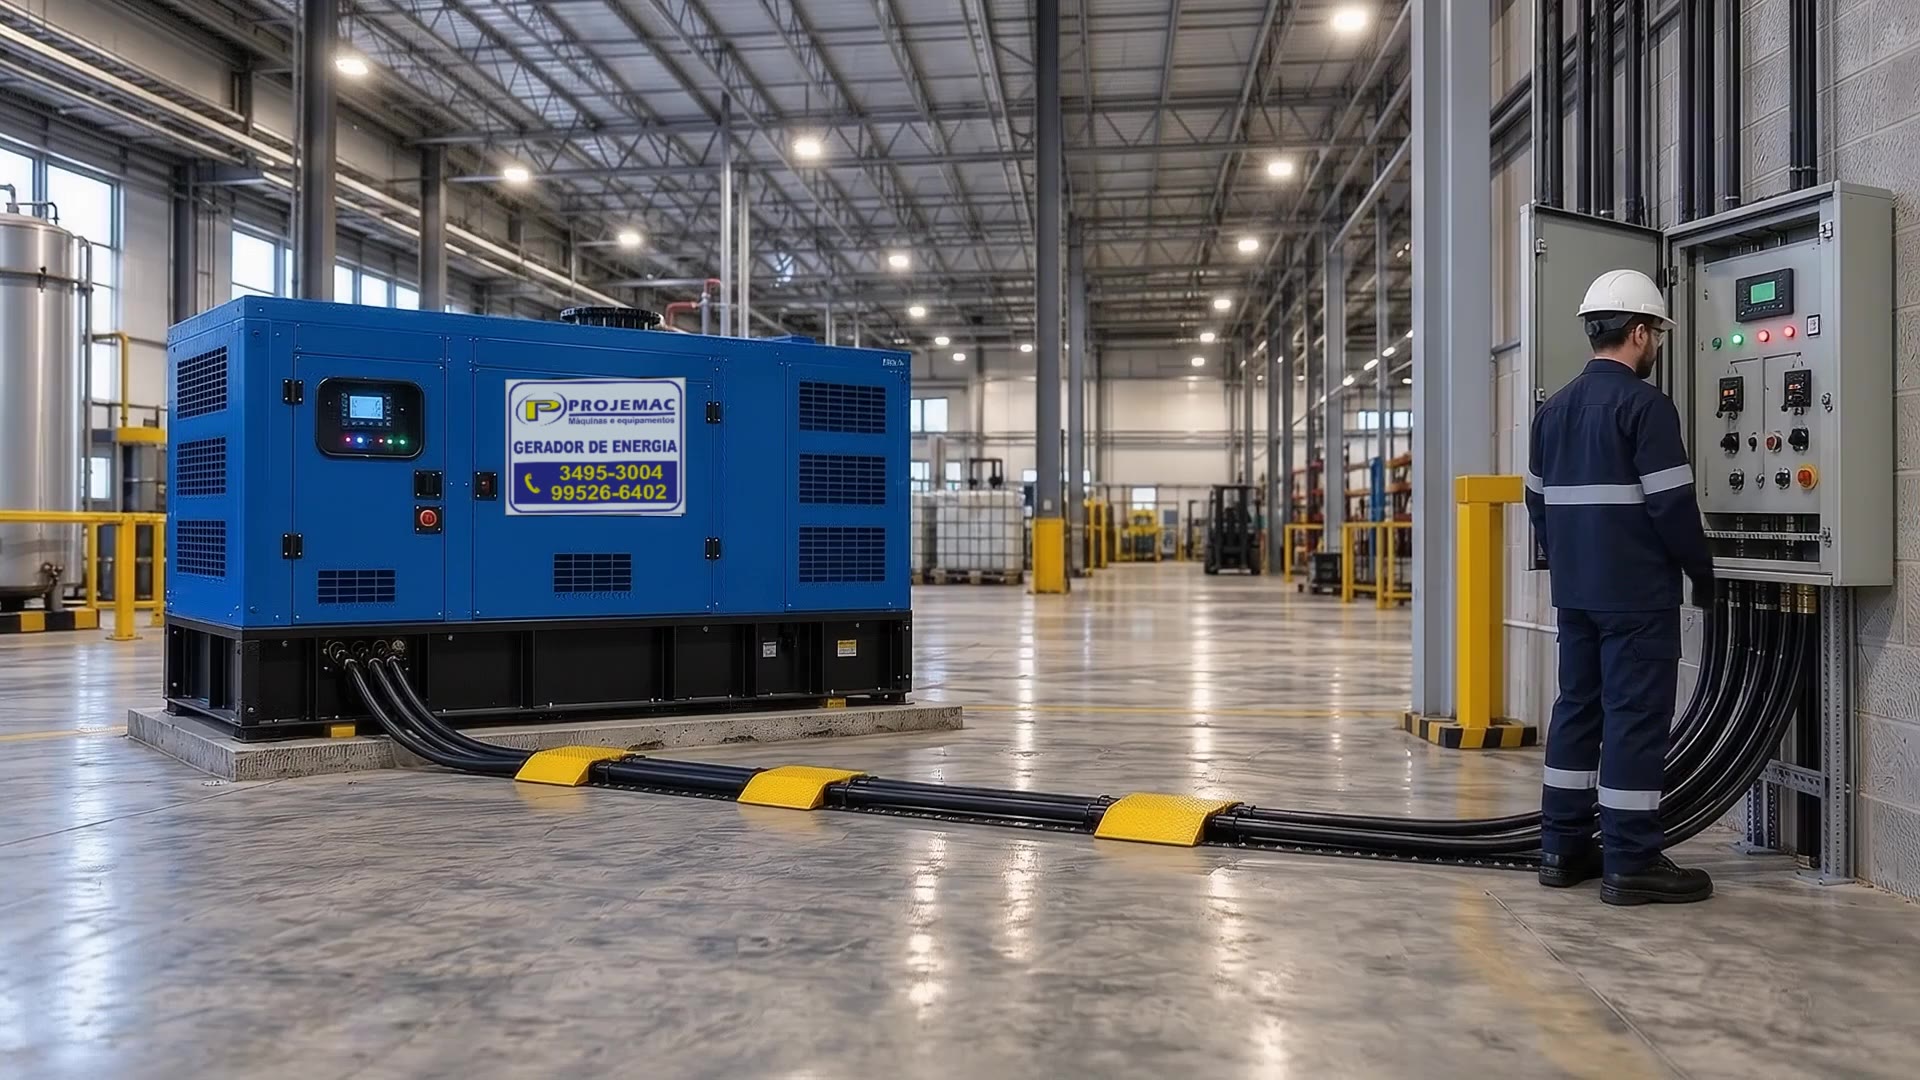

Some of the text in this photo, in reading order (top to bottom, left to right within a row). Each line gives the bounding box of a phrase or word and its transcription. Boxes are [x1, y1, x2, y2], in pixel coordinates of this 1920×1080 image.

[568, 398, 675, 412] PROJEMAC
[568, 417, 608, 426] Máquinas
[617, 416, 675, 426] equipamentos
[513, 439, 677, 454] GERADOR DE ENERGIA
[559, 464, 663, 481] 3495-3004
[551, 484, 667, 501] 99526-6402
